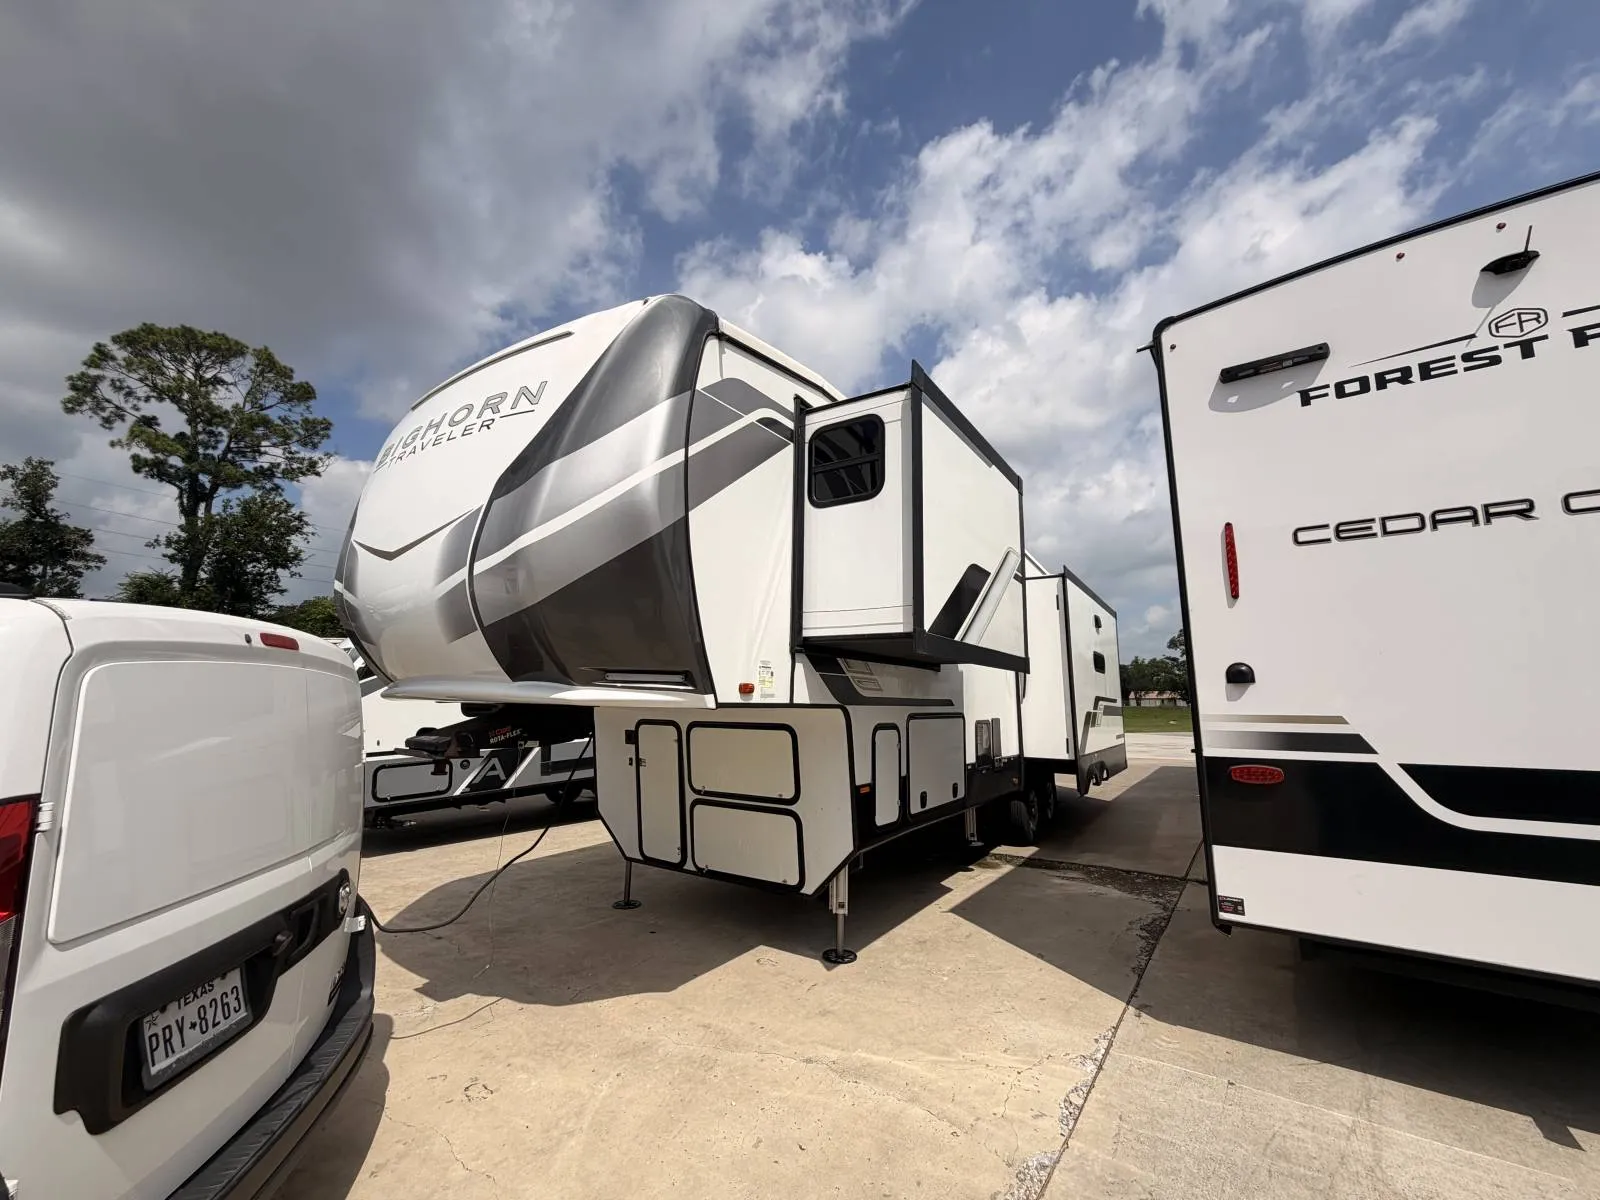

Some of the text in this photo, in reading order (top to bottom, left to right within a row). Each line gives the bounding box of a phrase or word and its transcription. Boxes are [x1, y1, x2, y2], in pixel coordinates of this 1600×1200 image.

[1296, 334, 1549, 408] FOREST
[376, 381, 548, 469] BIGHORN
[388, 418, 495, 469] TRAVELER
[1292, 498, 1540, 547] CEDAR
[176, 981, 215, 1010] TEXAS
